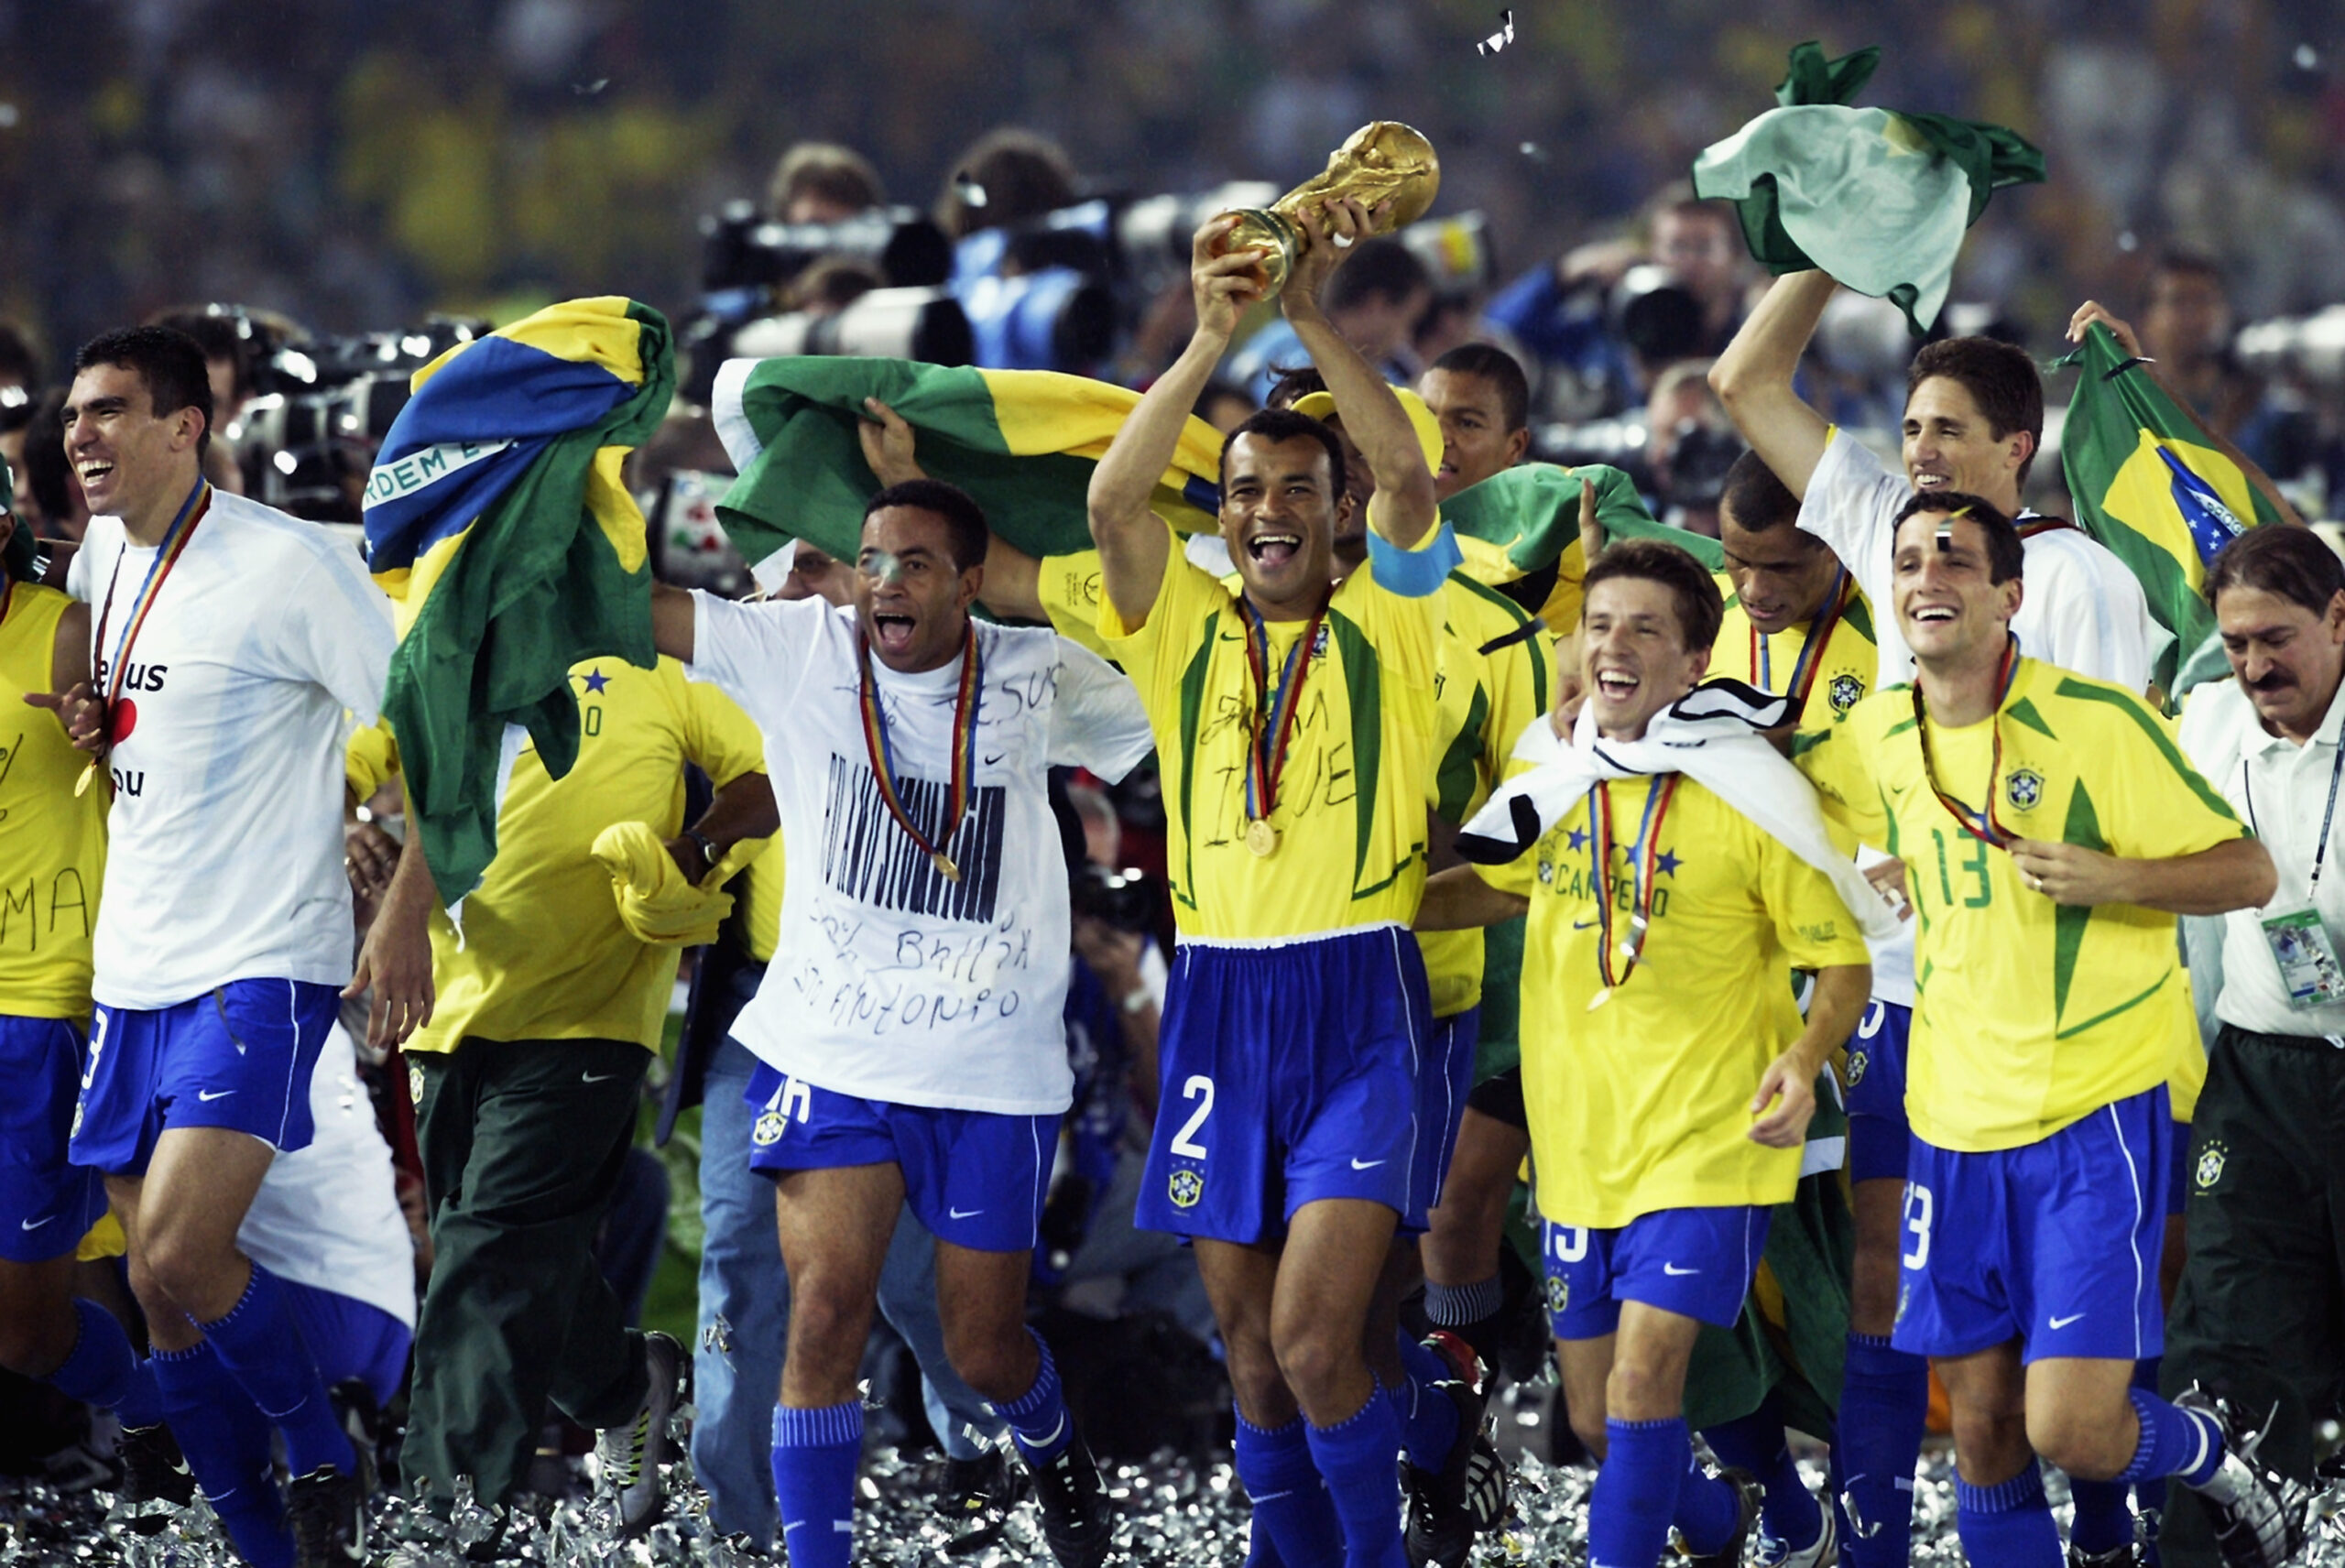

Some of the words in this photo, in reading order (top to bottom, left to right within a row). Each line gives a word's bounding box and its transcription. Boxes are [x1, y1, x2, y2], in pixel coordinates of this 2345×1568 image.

[366, 449, 447, 503] RDEM
[100, 659, 169, 691] eus
[1931, 827, 1991, 909] 13
[1170, 1074, 1215, 1160] 2
